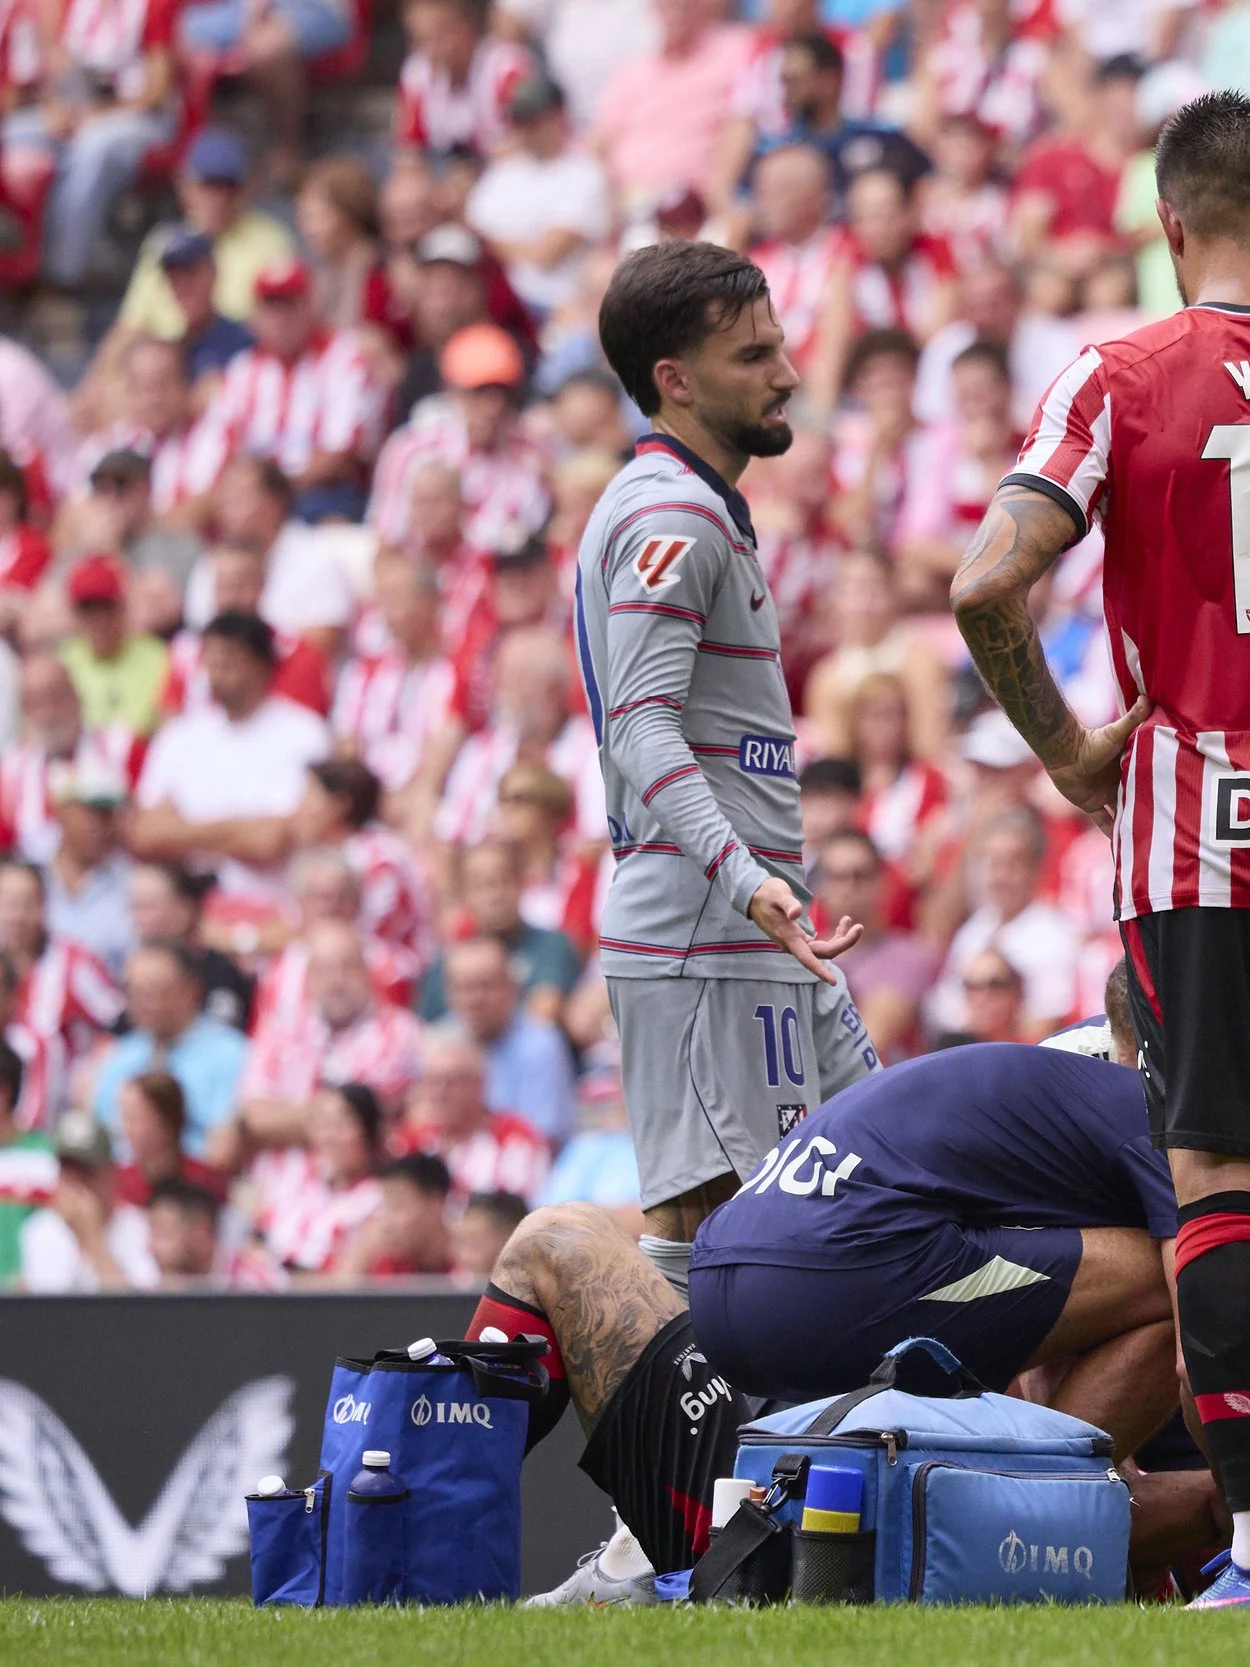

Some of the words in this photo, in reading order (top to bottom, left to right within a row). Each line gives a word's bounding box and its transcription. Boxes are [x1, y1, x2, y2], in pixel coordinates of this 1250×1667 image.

[745, 740, 795, 773] RIYA
[753, 1004, 806, 1087] 10
[436, 1402, 494, 1430] IMQ
[1030, 1545, 1095, 1580] IMQ
